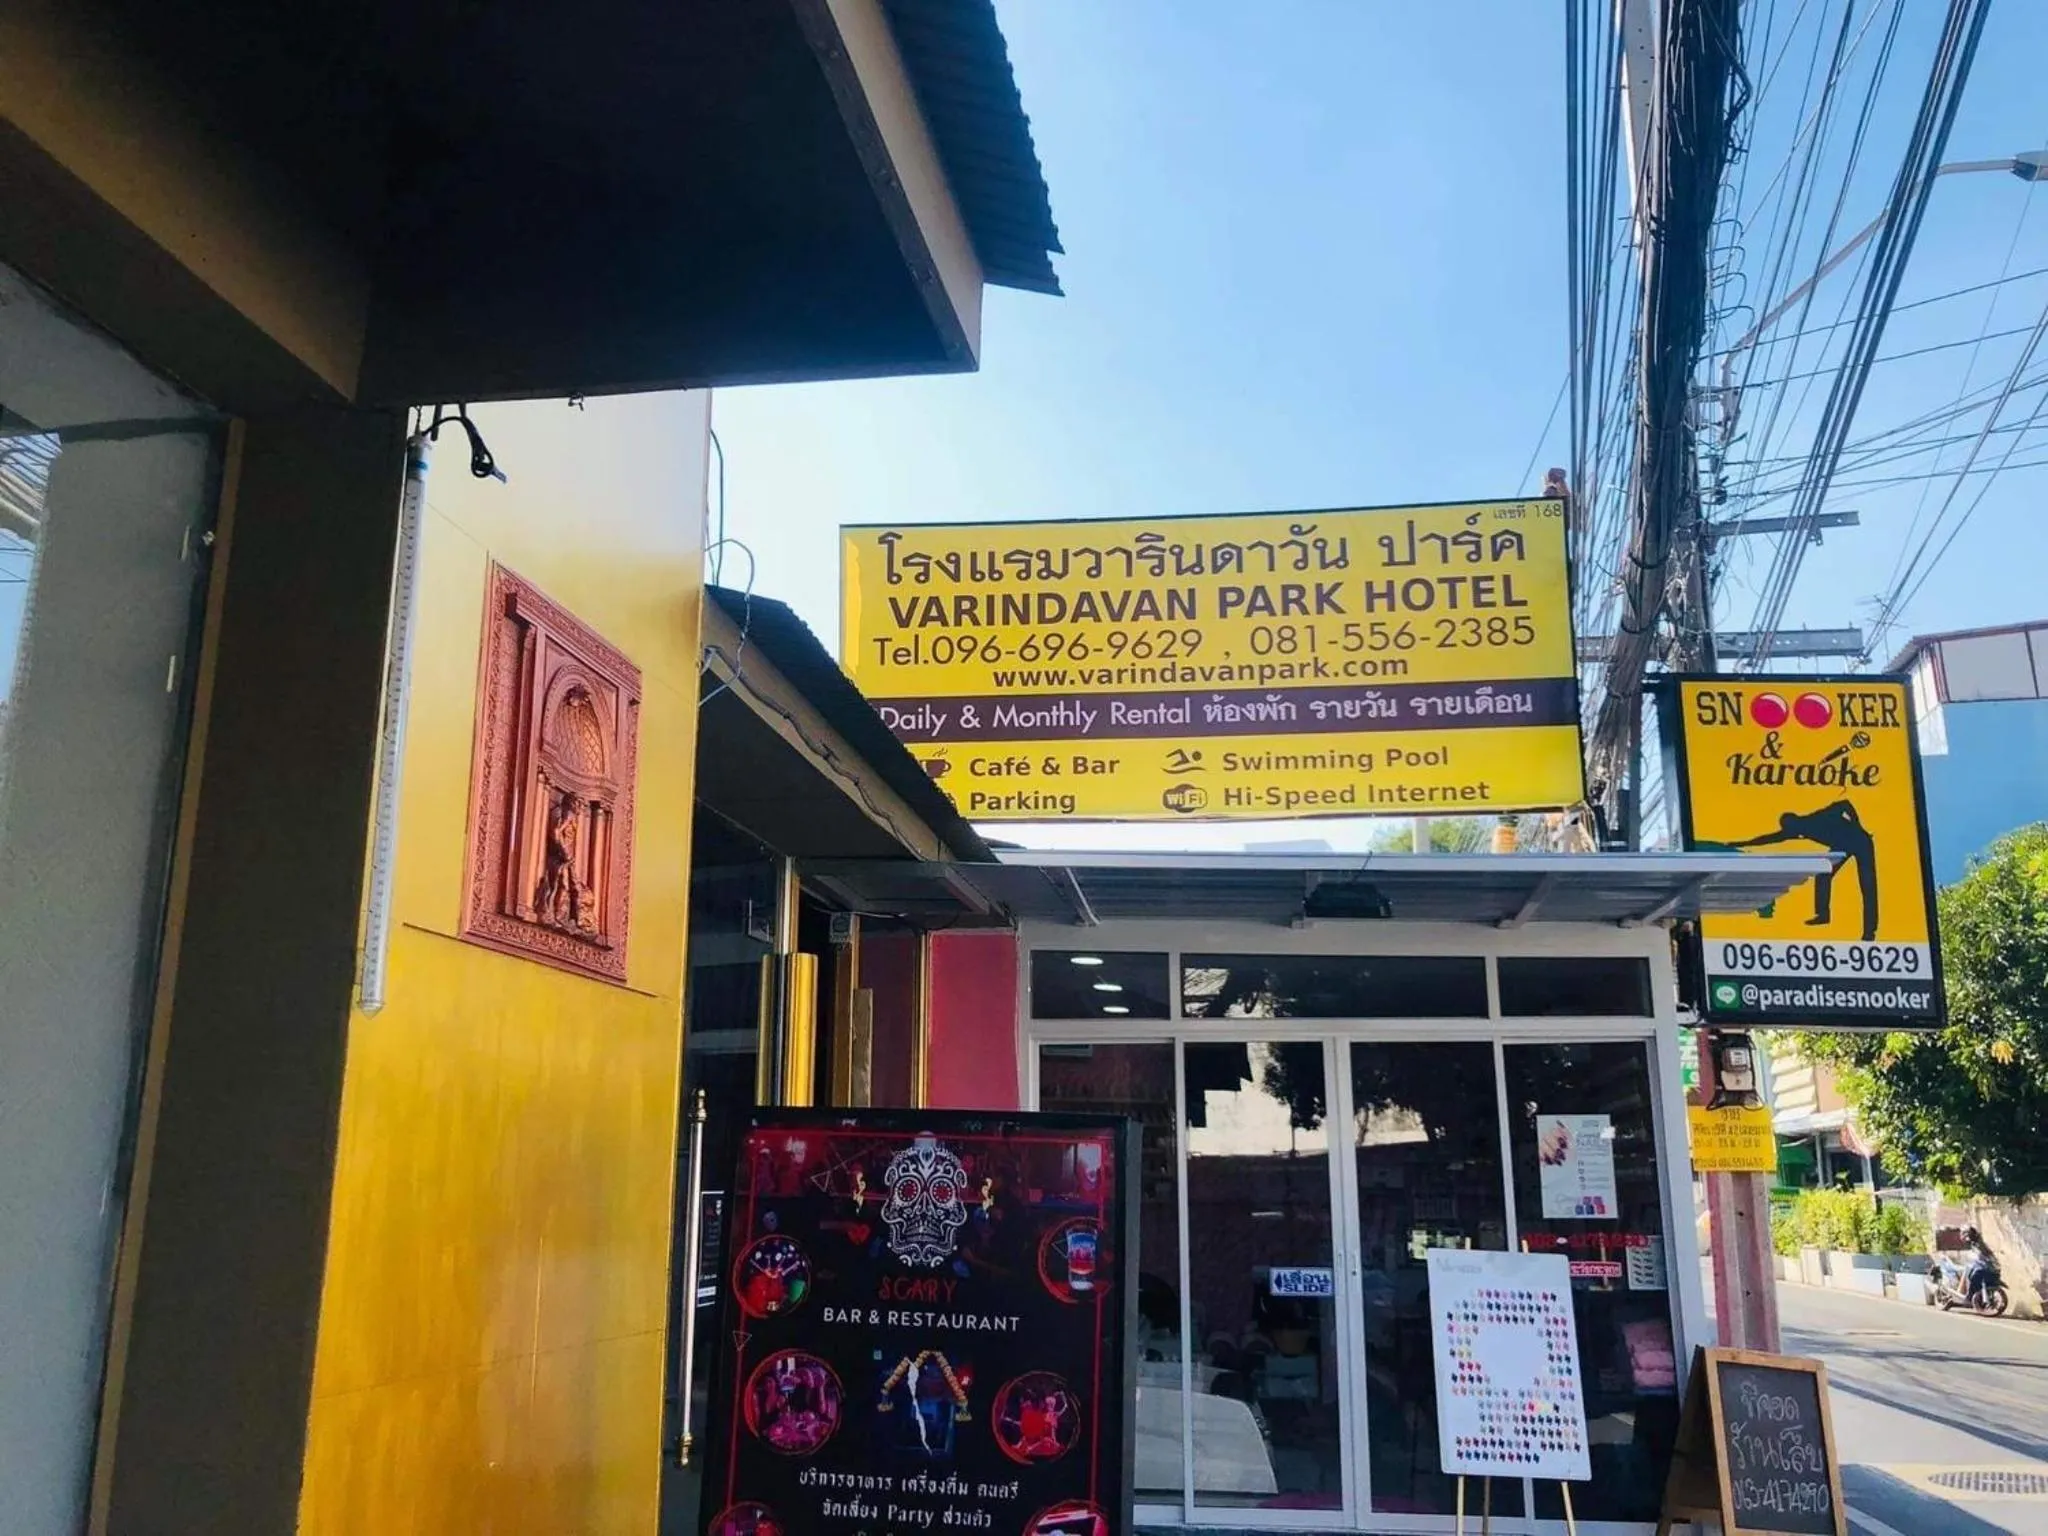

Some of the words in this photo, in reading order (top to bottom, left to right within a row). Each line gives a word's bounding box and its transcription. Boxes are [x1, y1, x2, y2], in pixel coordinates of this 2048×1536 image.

[1535, 503, 1562, 518] 168
[878, 523, 1349, 585] โรงแรมวารินดาวัน
[1378, 512, 1526, 568] ปาร์ค
[889, 587, 1196, 629] VARINDAVAN
[1218, 581, 1347, 619] PARK
[1364, 573, 1528, 613] HOTEL
[1250, 615, 1535, 656] 081-556-2385
[993, 656, 1408, 687] www.varindavanpark.com
[879, 703, 947, 736] Daily
[959, 704, 982, 729] &
[993, 702, 1098, 733] Monthly
[1110, 697, 1191, 727] Rental
[1202, 693, 1297, 724] ห้องพัก
[1309, 690, 1398, 720] รายวัน
[1410, 686, 1532, 717] รายเดือน
[1222, 750, 1373, 773] Swimming
[1386, 746, 1449, 768] Pool
[1759, 730, 1784, 760] &
[969, 754, 1031, 777] Café
[1041, 755, 1061, 776] &
[1072, 754, 1120, 775] Bar
[1726, 752, 1881, 788] Karaoke
[970, 790, 1077, 814] Parking
[1224, 785, 1356, 810] Hi-Speed
[1368, 781, 1490, 803] Internet
[1722, 942, 1920, 974] 096-696-9629
[1741, 983, 1931, 1011] @paradisesnooker
[878, 1274, 958, 1304] SCARY
[1284, 1284, 1329, 1294] SLIDE
[823, 1306, 864, 1326] BAR
[868, 1309, 880, 1327] &
[888, 1310, 1020, 1333] RESTAURANT
[888, 1503, 934, 1529] Party
